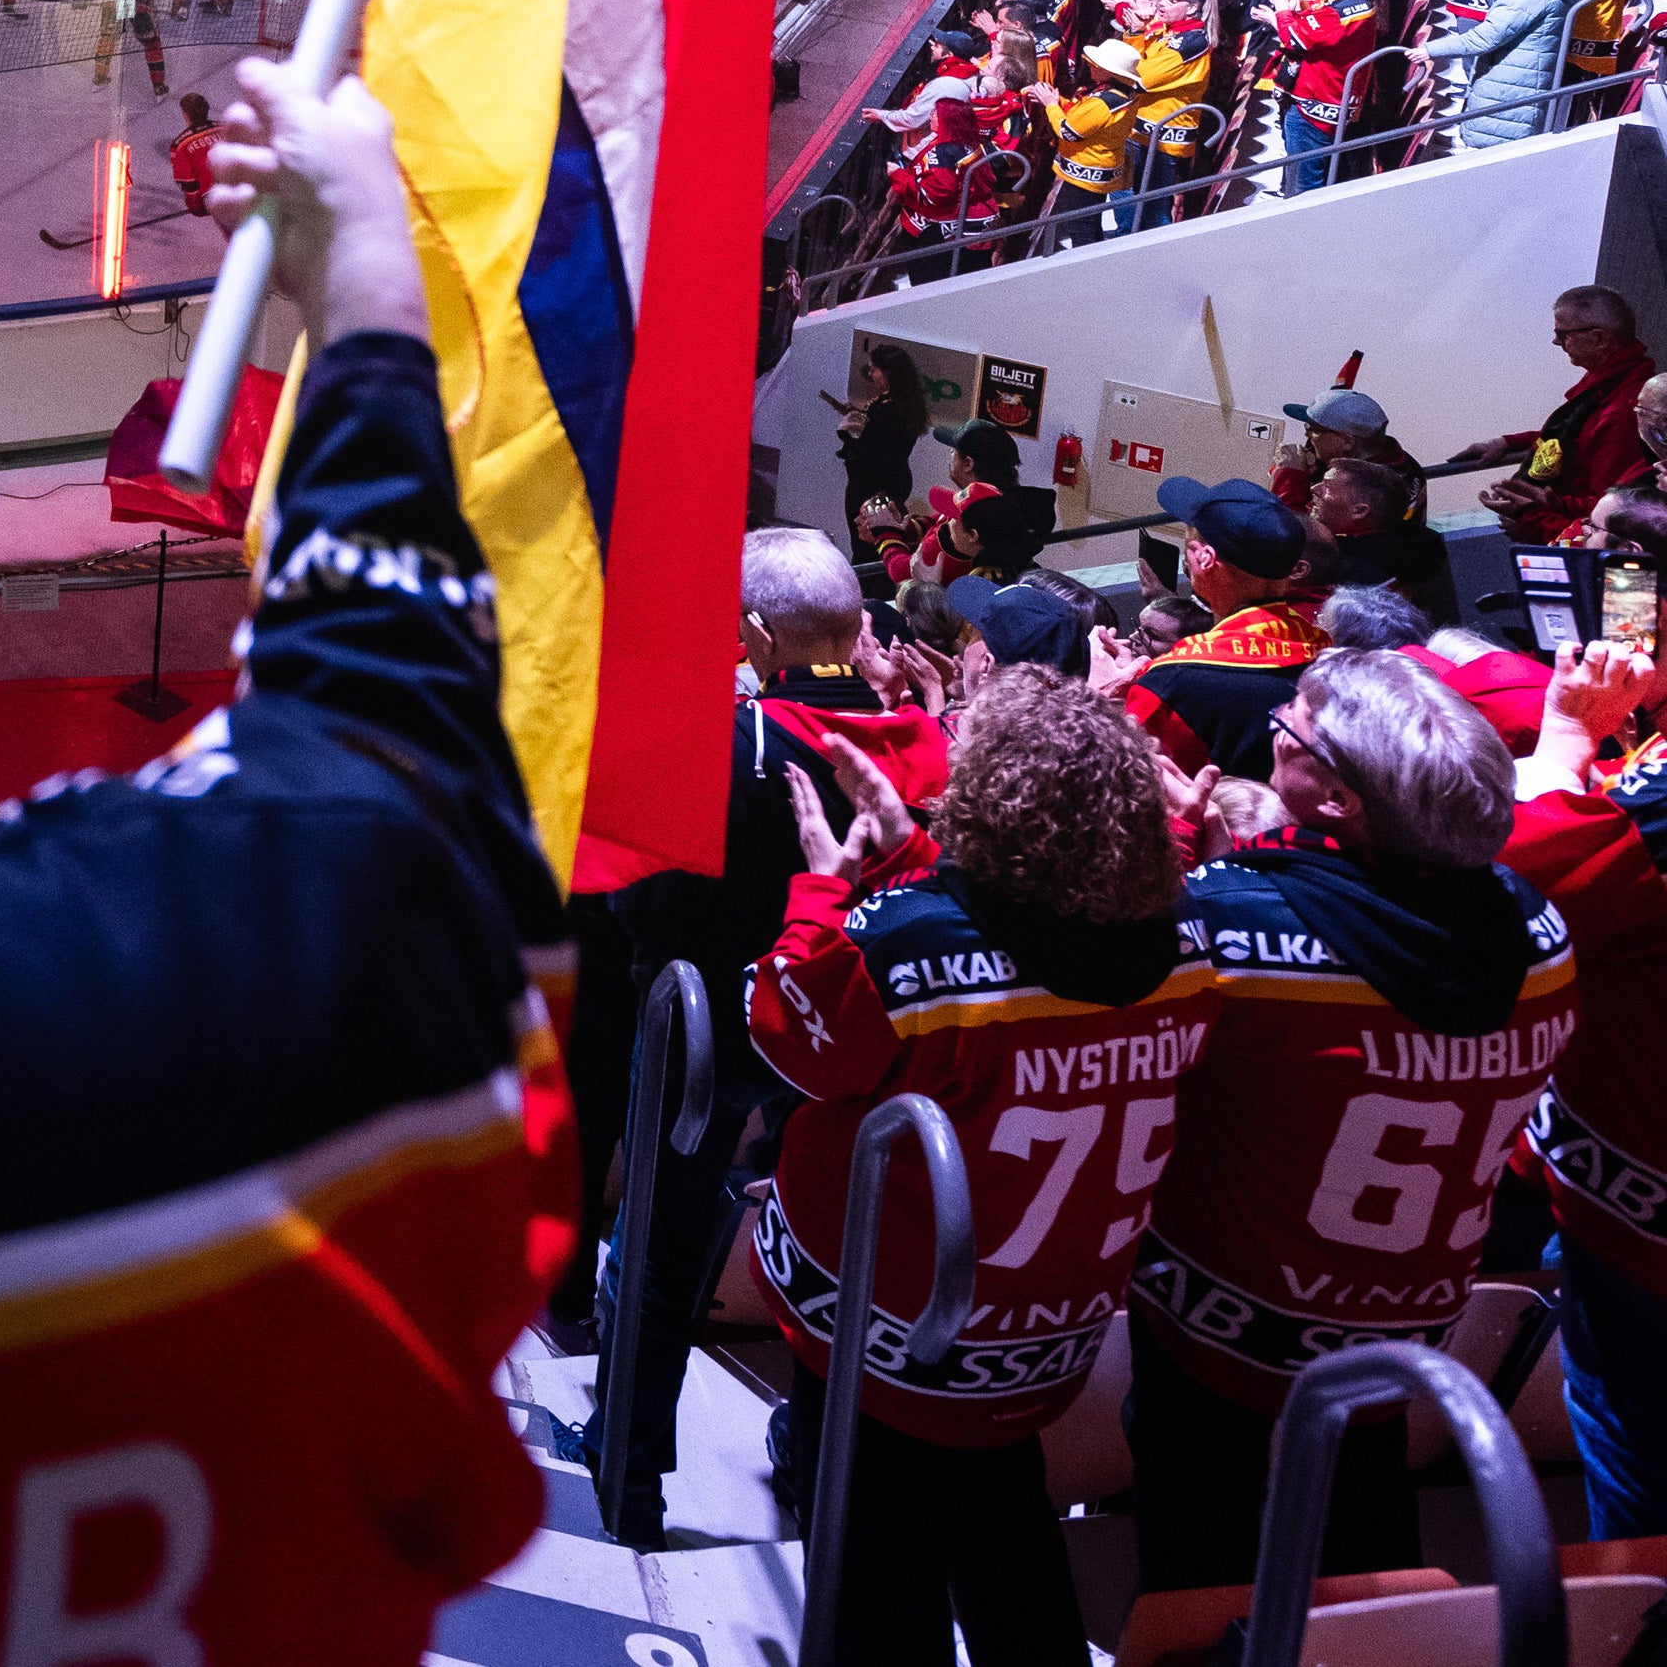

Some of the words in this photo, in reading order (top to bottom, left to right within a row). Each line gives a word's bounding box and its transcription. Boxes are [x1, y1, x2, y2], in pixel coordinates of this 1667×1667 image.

[1063, 161, 1102, 182] SSAB
[990, 364, 1037, 386] BILJETT
[1255, 932, 1347, 966] LKA
[921, 951, 1017, 990] LKAB
[1138, 1261, 1256, 1340] AB
[1280, 1264, 1471, 1307] VINA
